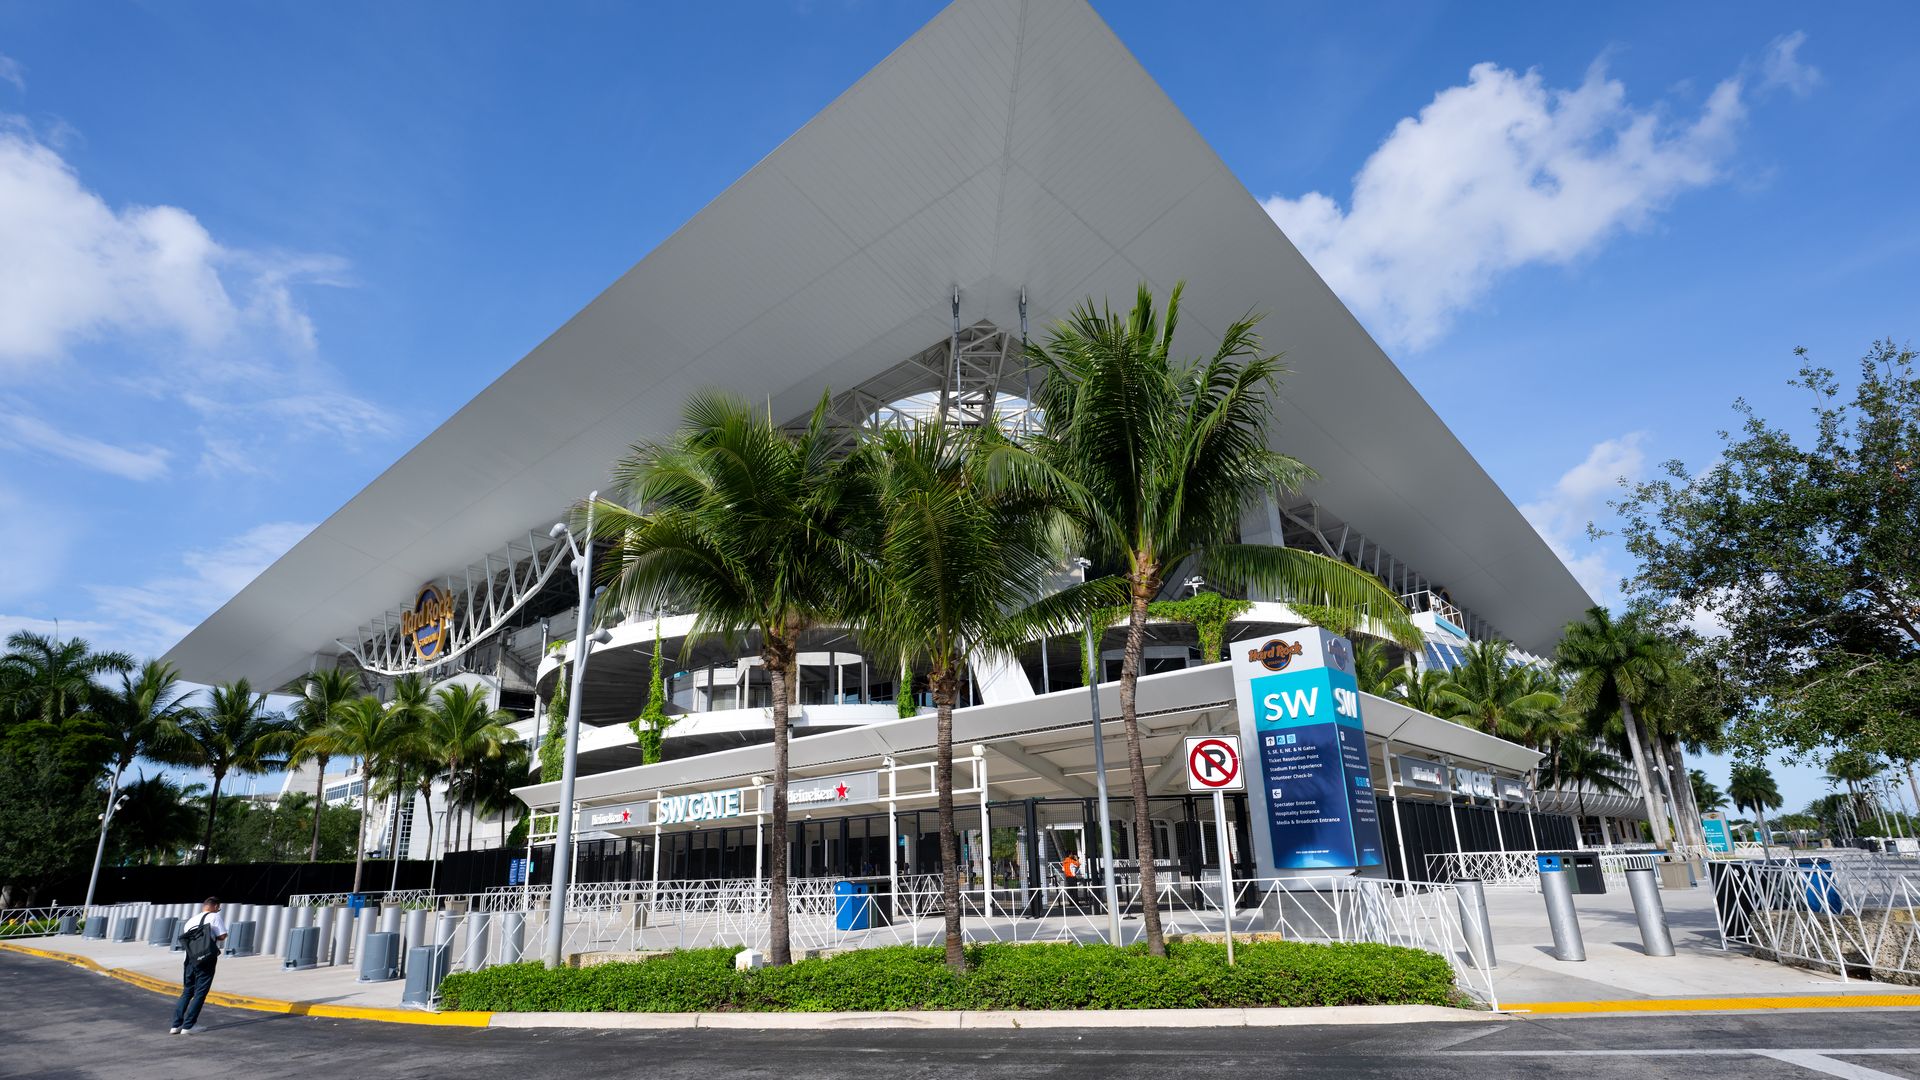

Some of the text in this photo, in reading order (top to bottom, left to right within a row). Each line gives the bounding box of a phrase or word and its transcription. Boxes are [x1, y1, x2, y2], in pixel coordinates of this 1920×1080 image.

[402, 589, 454, 636] Hard Rock
[1248, 646, 1275, 662] Hard
[1276, 641, 1303, 658] Rock
[1263, 687, 1319, 721] SW
[1335, 687, 1358, 719] SW
[1204, 749, 1226, 777] P
[659, 788, 740, 824] SW GATE
[787, 787, 835, 804] Heineken
